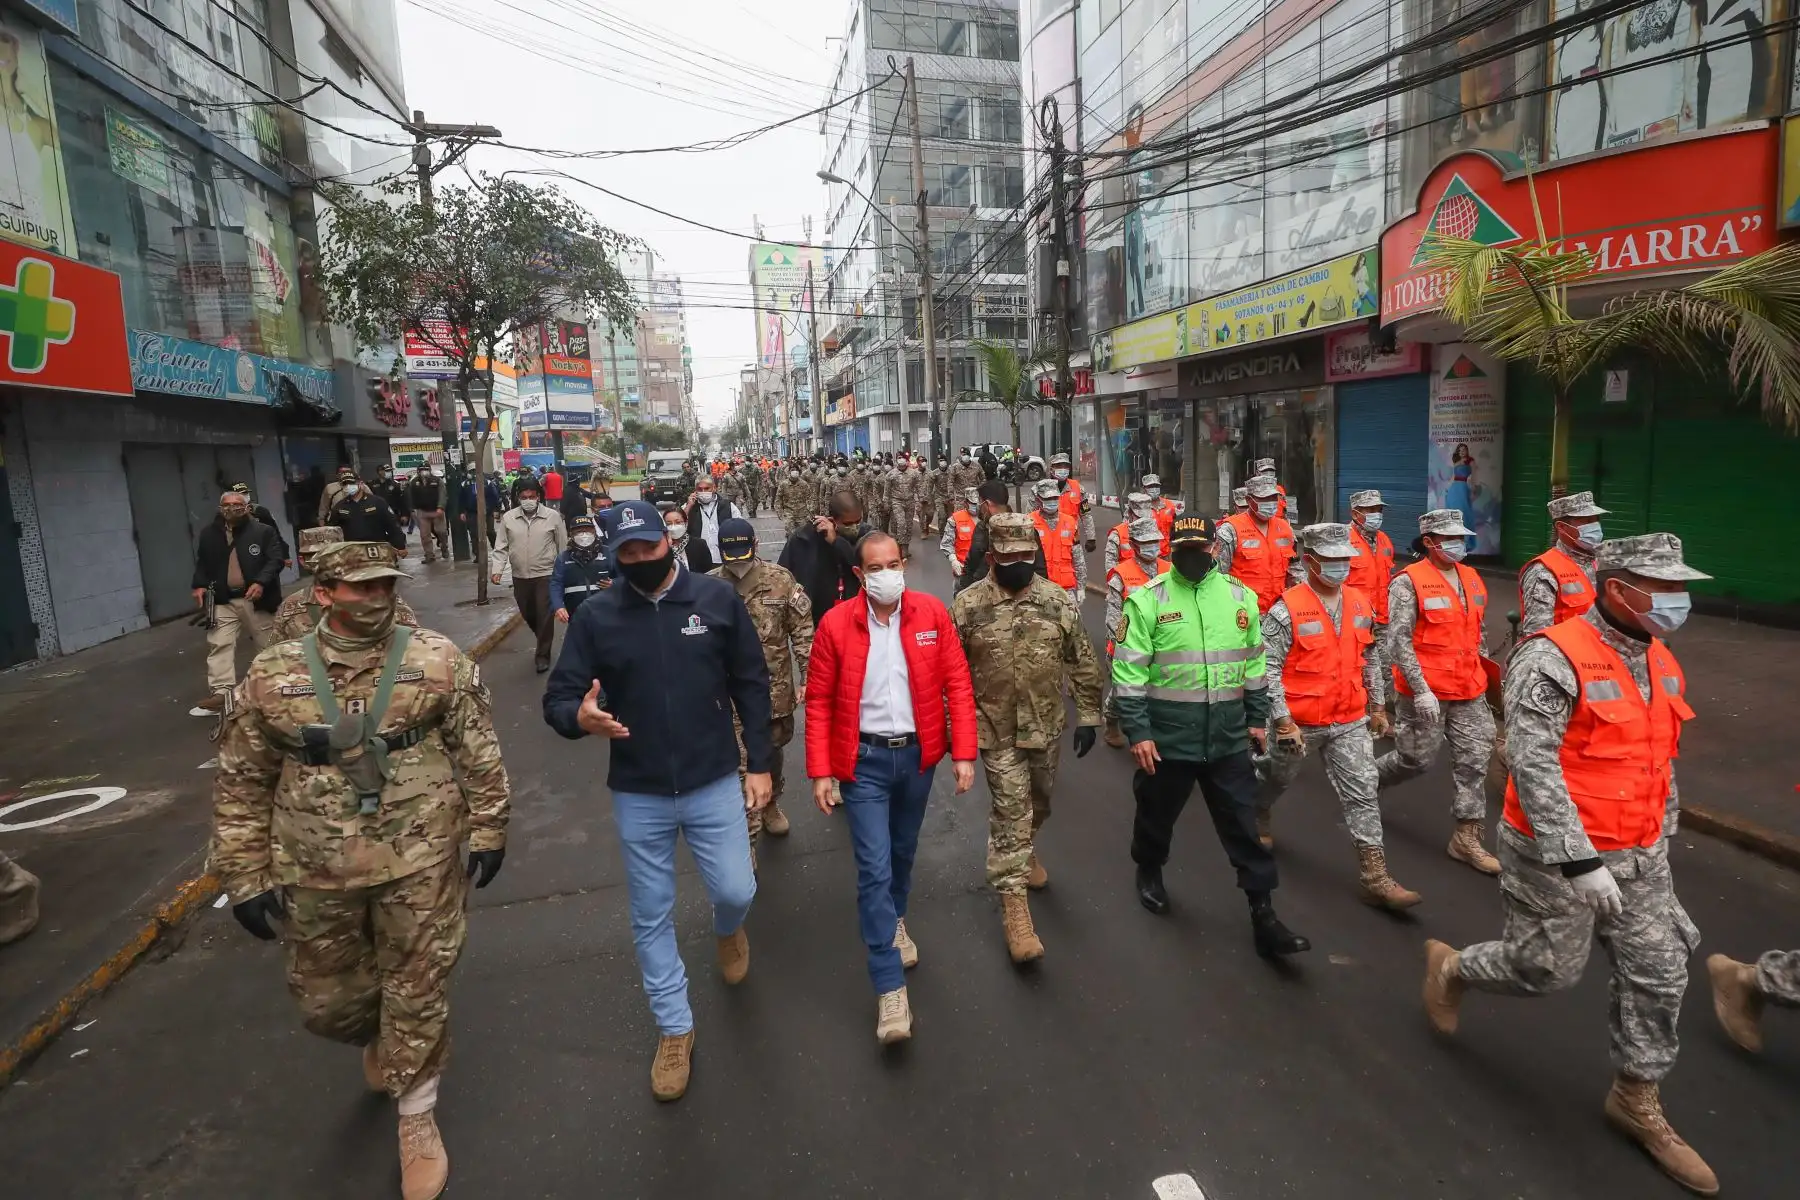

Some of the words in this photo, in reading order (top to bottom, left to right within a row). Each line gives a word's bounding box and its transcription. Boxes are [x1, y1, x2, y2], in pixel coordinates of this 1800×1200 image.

[0, 212, 60, 246] GUIPIUR
[1266, 282, 1286, 297] CASA
[1287, 279, 1298, 291] DE
[1298, 268, 1330, 288] CAMBIO
[1382, 289, 1393, 315] LA
[135, 332, 208, 371] Centro
[550, 358, 587, 374] Norky's
[1190, 352, 1301, 387] ALMENDRA
[564, 381, 588, 390] movistar
[1174, 517, 1205, 532] POLICIA
[1581, 662, 1615, 671] MARINA
